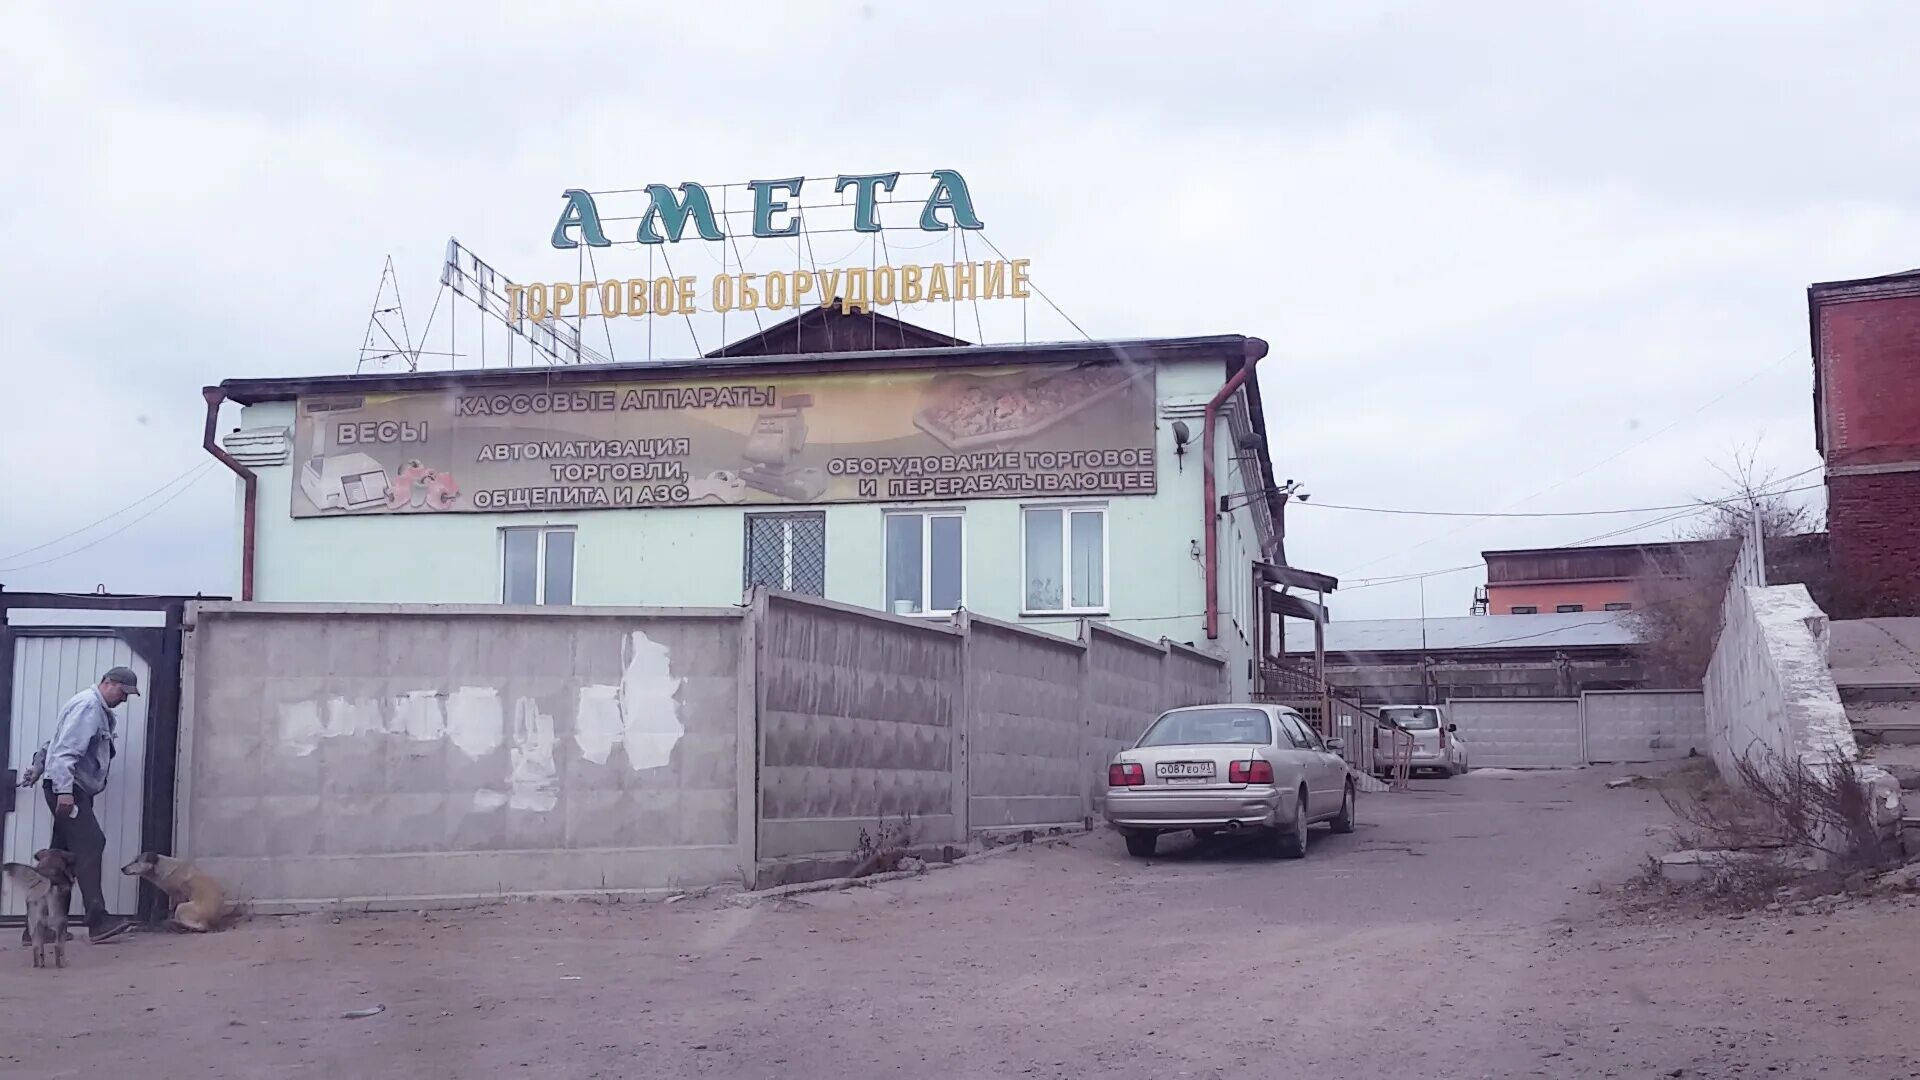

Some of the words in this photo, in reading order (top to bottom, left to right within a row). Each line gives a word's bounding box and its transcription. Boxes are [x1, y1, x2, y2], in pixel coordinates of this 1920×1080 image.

[551, 169, 984, 249] АМЕТА
[505, 275, 697, 324] ТОРГОВОЕ
[712, 258, 1031, 316] ОБОРУДОВАНИЕ
[454, 391, 615, 417] КАССОВЫЕ
[620, 386, 775, 412] АППАРАТЫ
[337, 421, 428, 445] ВЕСЫ
[477, 438, 690, 461] АВТОМАТИЗАЦИЯ
[551, 462, 689, 483] ТОРГОВЛИ,
[827, 452, 1020, 476] ОБОРУДОВАНИЕ
[1024, 449, 1154, 470] ТОРГОВОЕ
[858, 479, 877, 496] И
[888, 471, 1154, 496] ПЕРЕРАБАТЫВАЮЩЕЕ
[474, 486, 608, 508] ОБЩЕПИТА
[613, 487, 632, 503] И
[636, 486, 690, 503] АЗС
